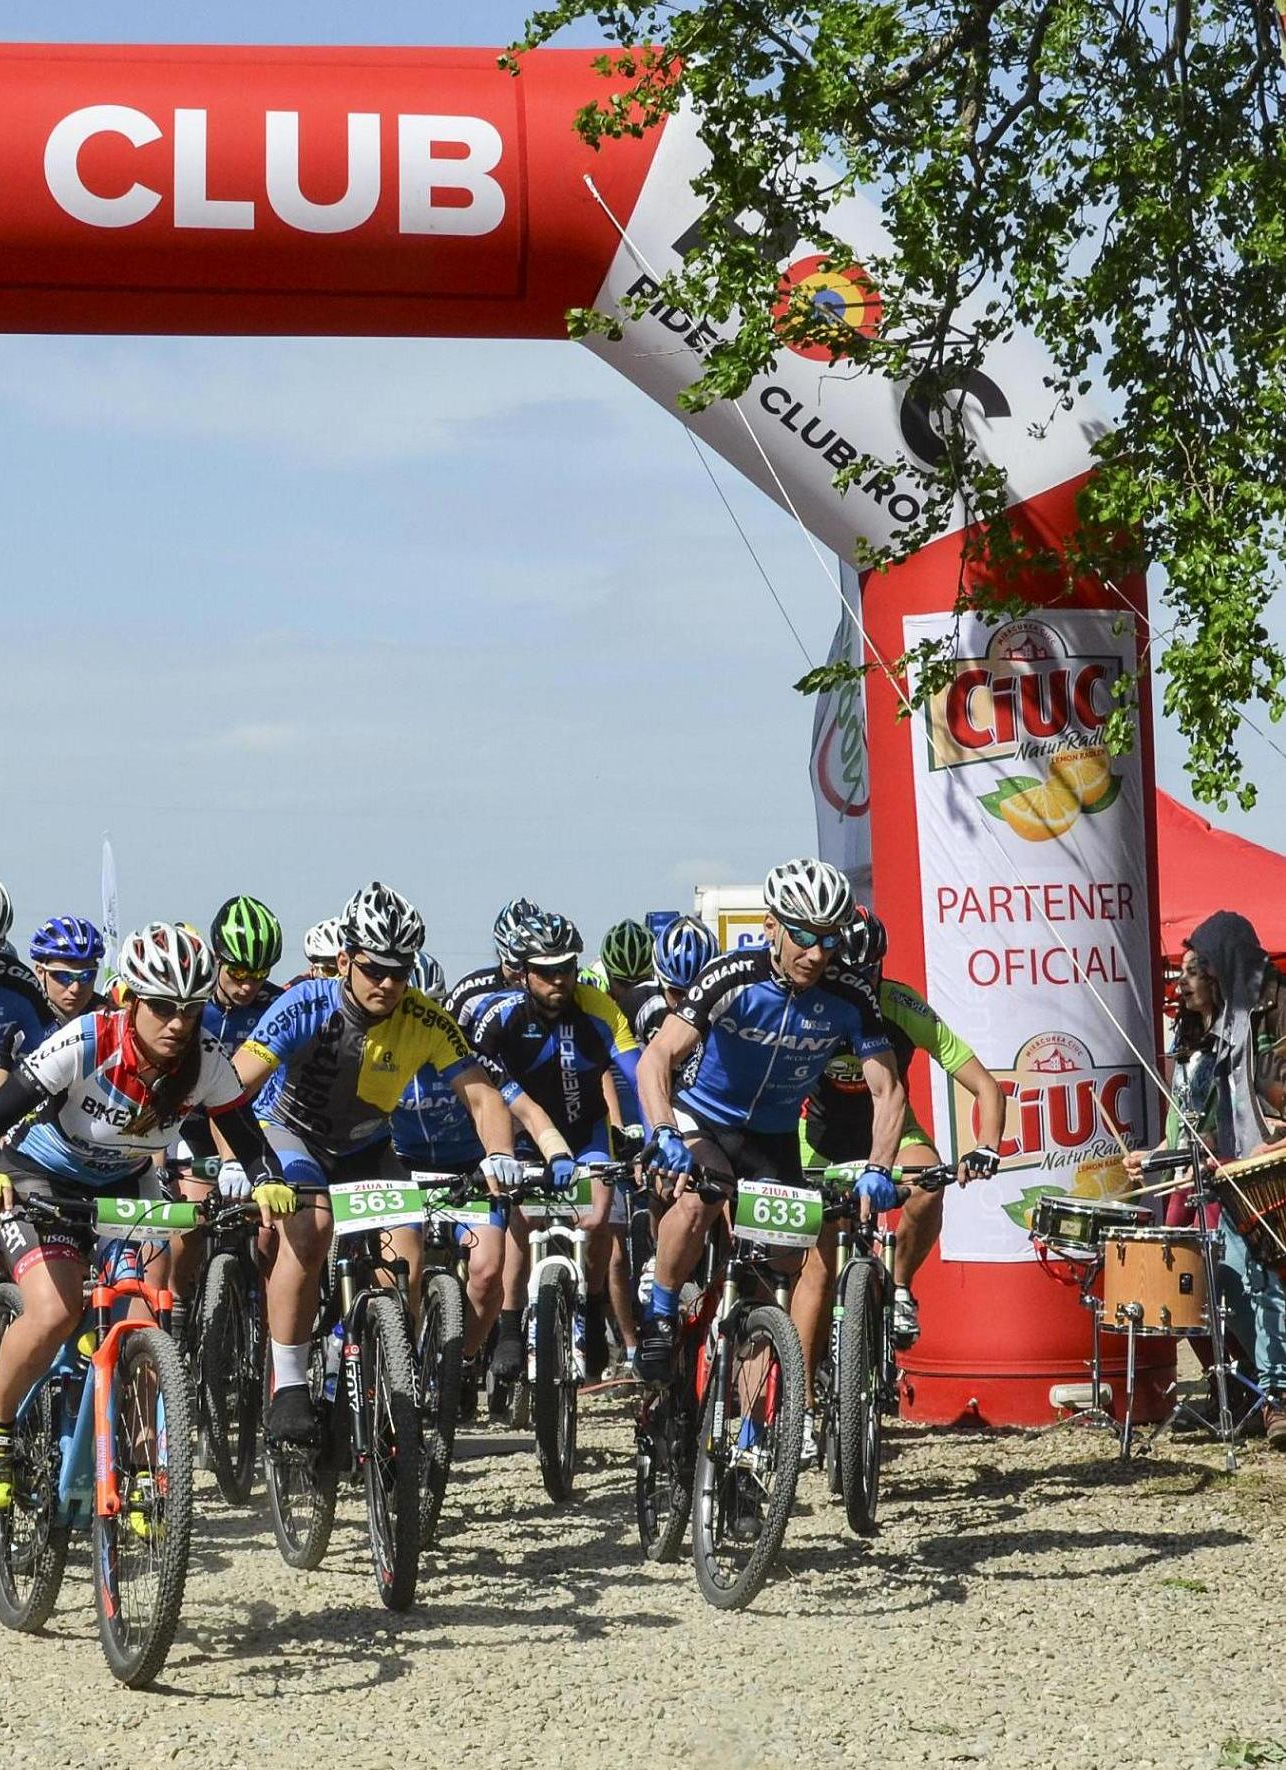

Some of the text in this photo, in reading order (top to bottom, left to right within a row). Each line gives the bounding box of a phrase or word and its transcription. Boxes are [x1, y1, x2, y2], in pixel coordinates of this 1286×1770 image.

[43, 104, 505, 236] CLUB
[937, 883, 1134, 924] PARTENER
[701, 960, 755, 989] GIANT
[968, 946, 1128, 987] OFICIAL
[452, 974, 496, 1001] GIANT
[474, 996, 525, 1043] OWERADE
[40, 1031, 94, 1060] CUBE
[737, 1028, 841, 1052] GIANT
[560, 1024, 582, 1123] POWERADE
[349, 1190, 405, 1215] 563
[761, 1186, 789, 1198] ZIUA
[753, 1197, 806, 1228] 633
